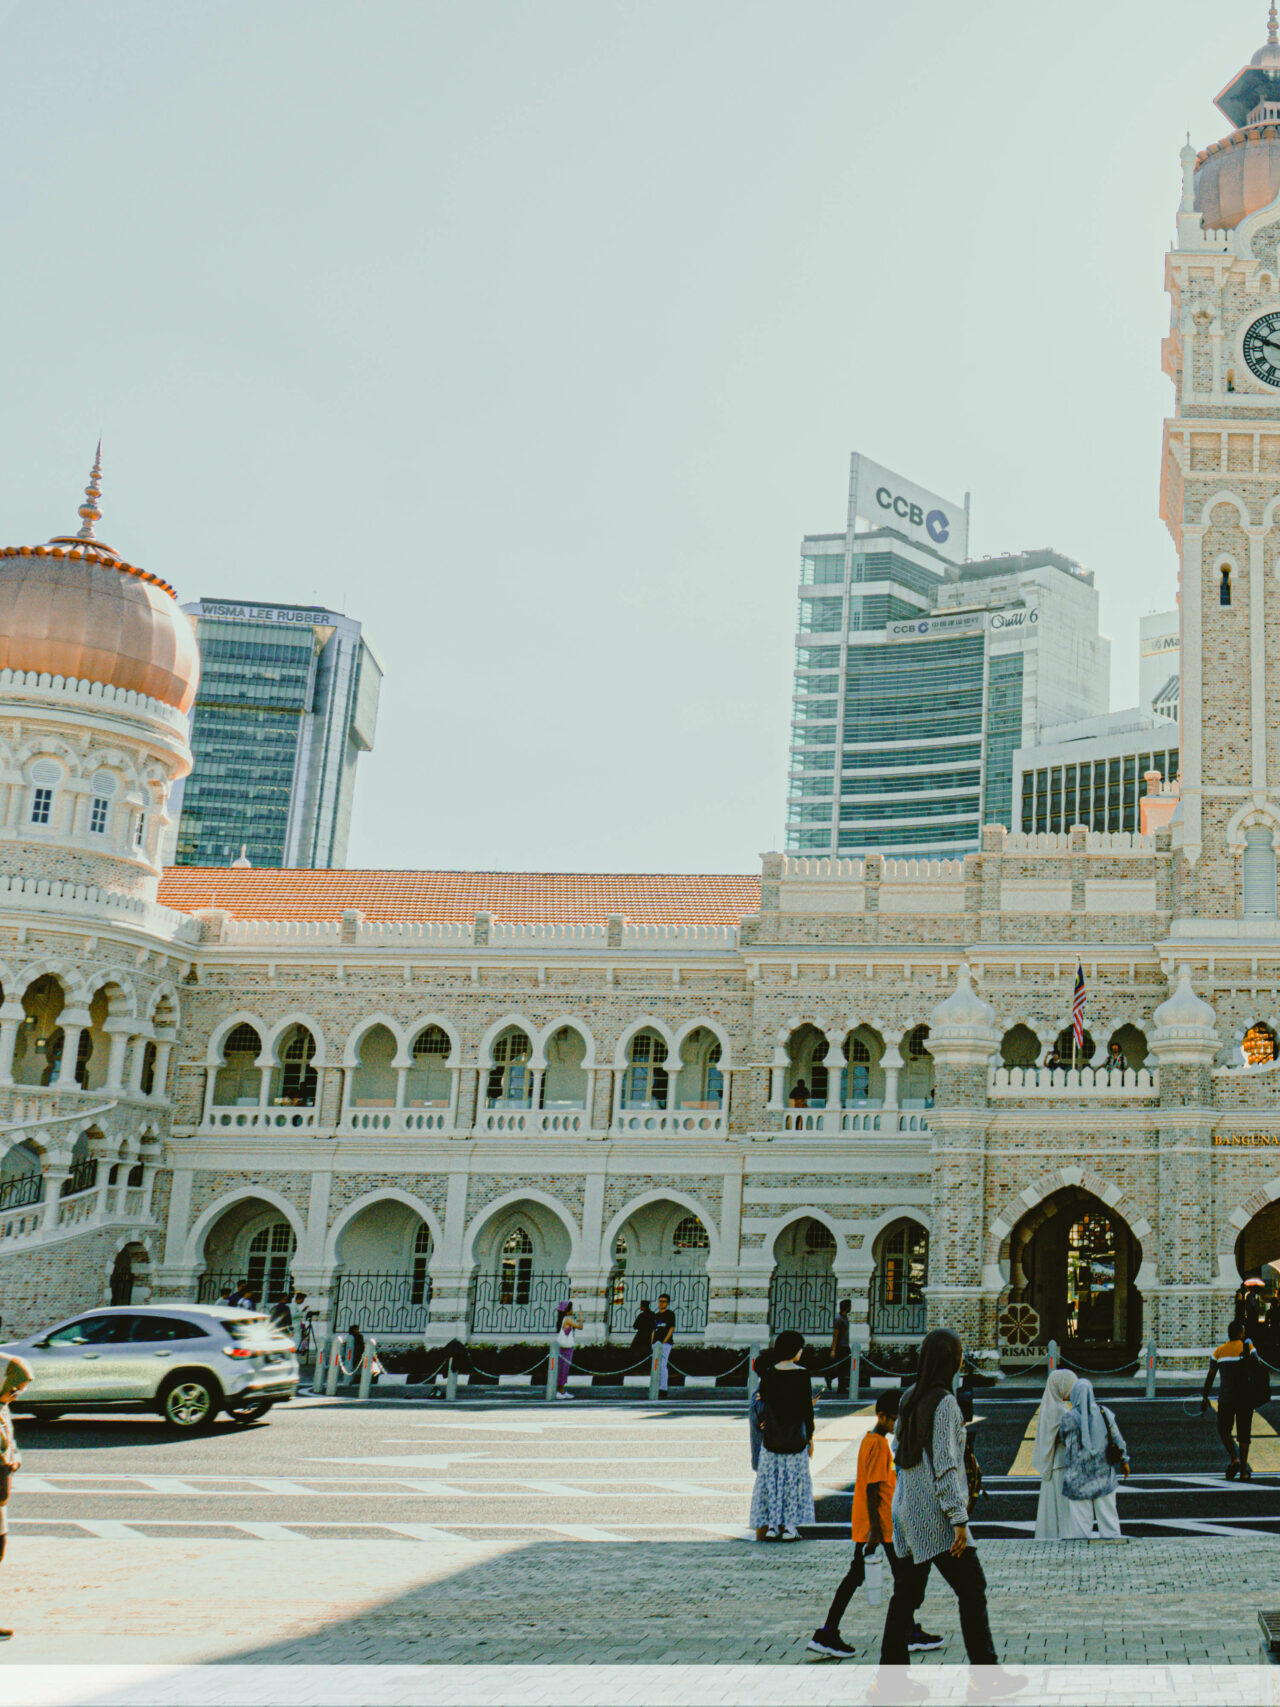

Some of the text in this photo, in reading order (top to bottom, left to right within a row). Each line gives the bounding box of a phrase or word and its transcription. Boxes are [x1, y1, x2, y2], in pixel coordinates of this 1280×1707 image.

[876, 487, 923, 526] CCB
[202, 604, 330, 624] WISMA LEE RUBBER
[1029, 608, 1039, 623] 6
[893, 625, 916, 634] CCB
[1002, 1347, 1035, 1357] RISAN
